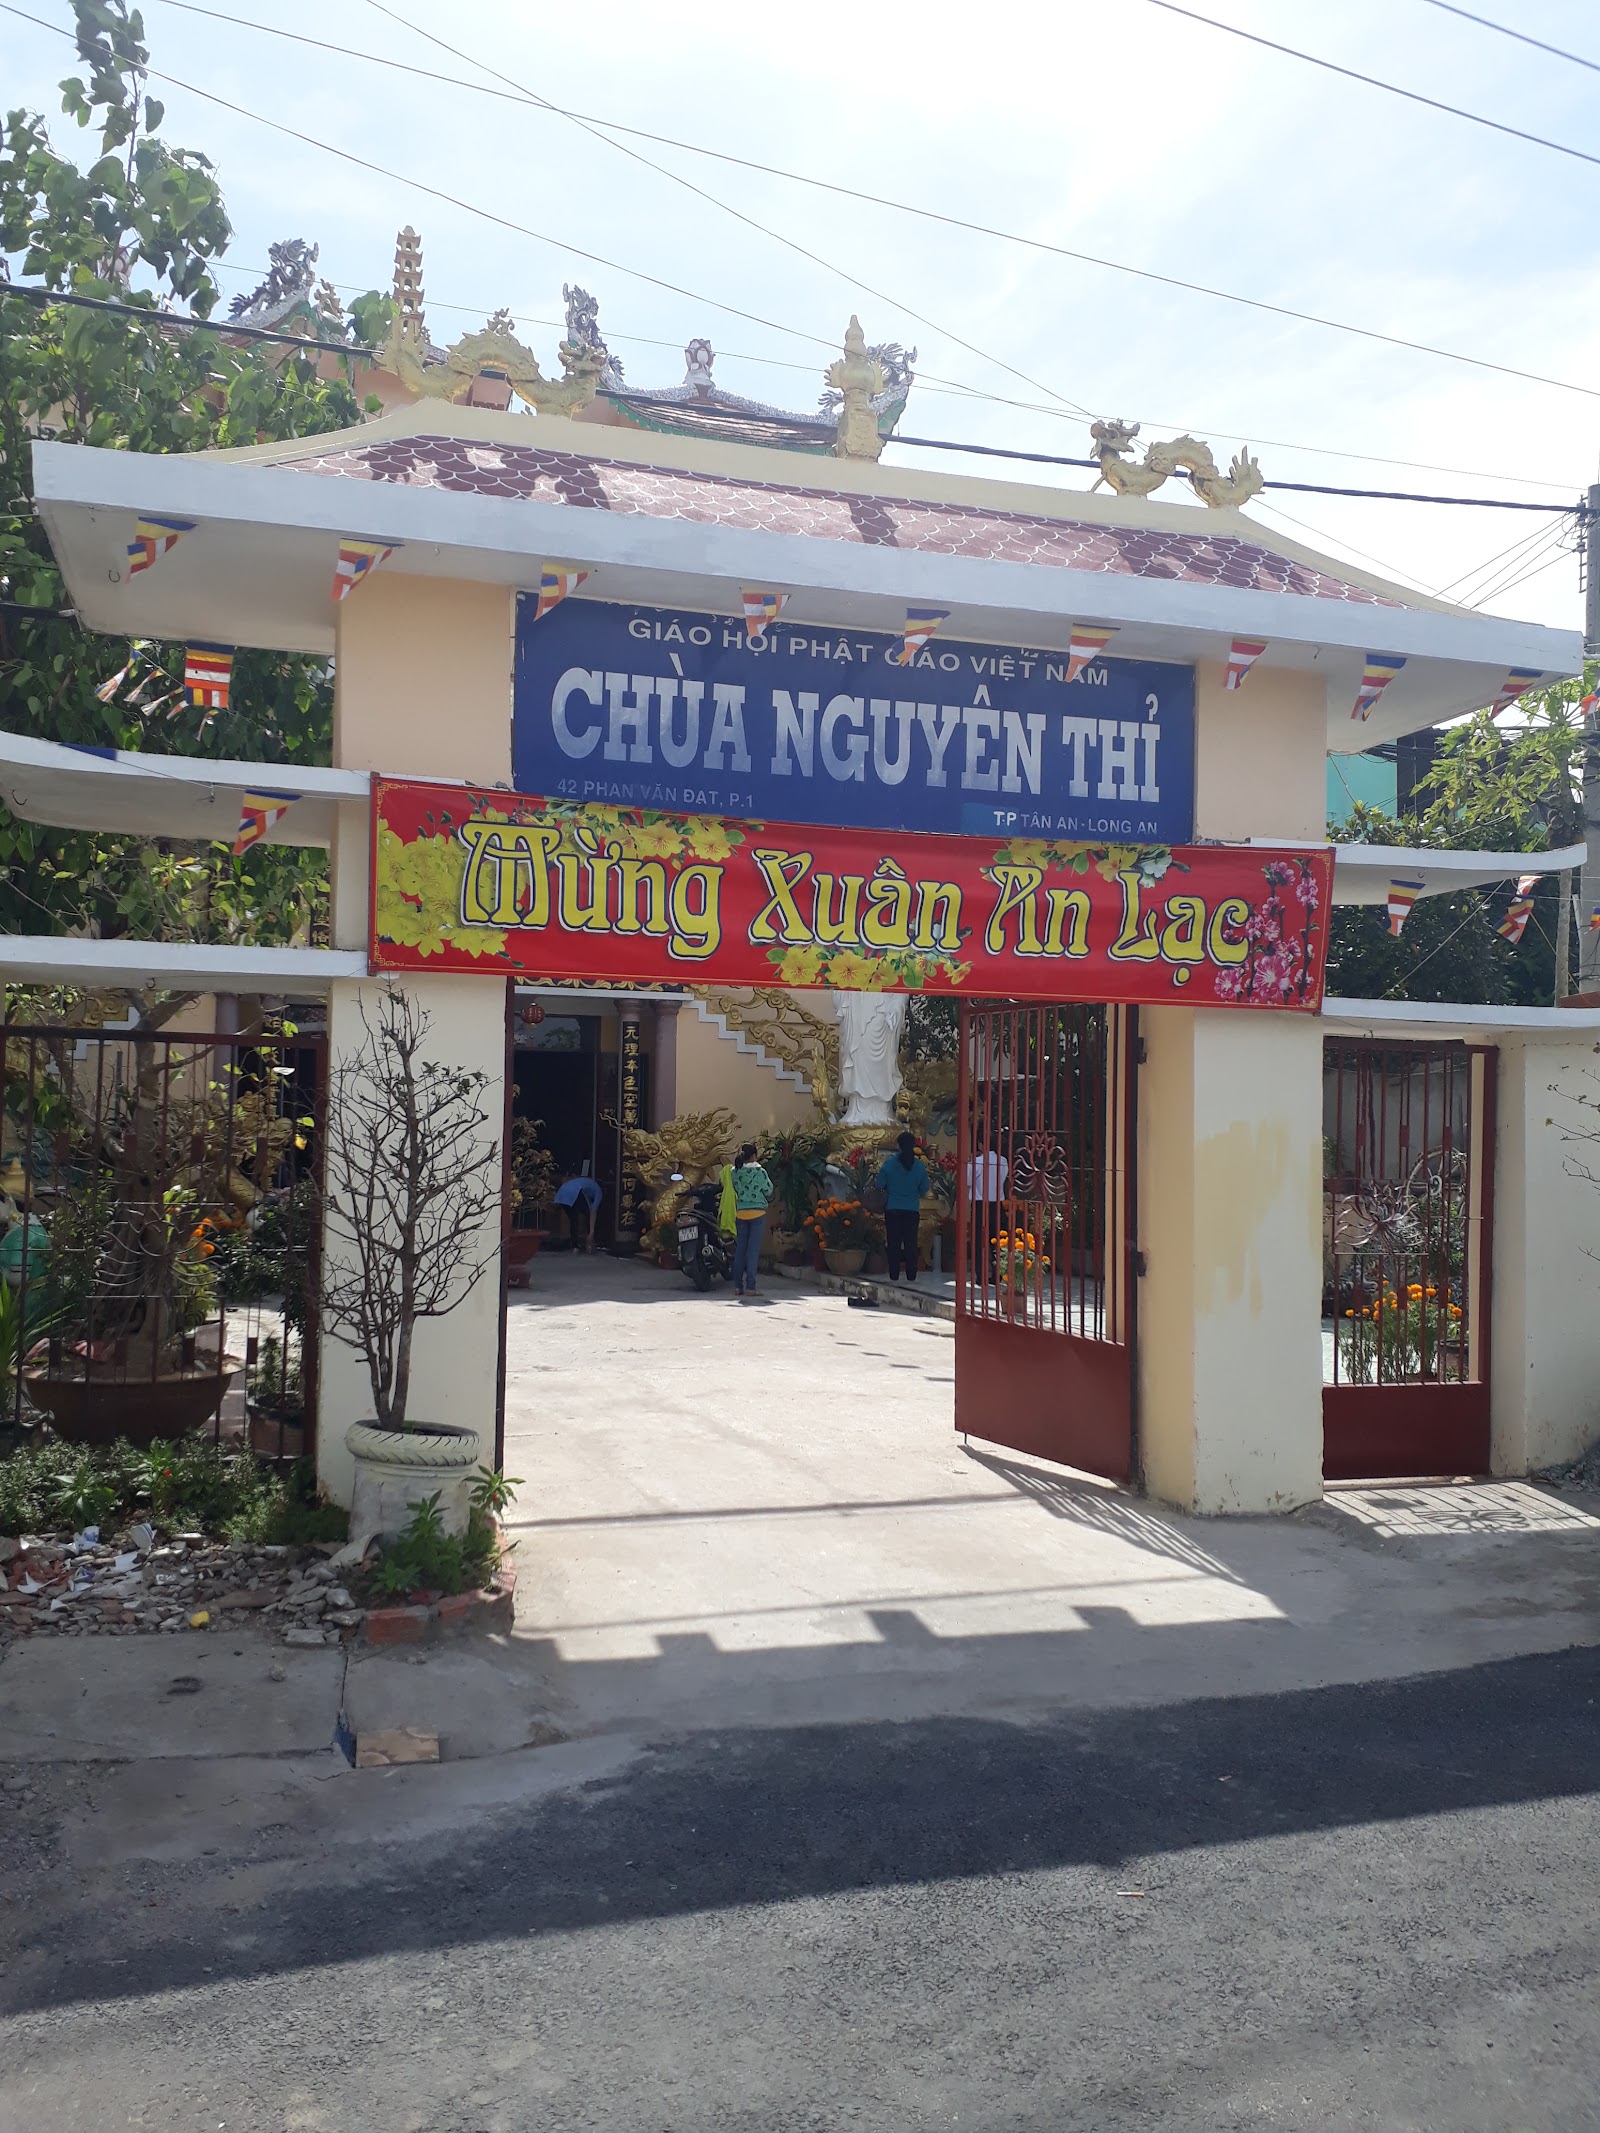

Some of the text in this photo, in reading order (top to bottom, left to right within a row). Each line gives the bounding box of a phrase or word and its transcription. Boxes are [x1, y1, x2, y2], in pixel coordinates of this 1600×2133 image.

[628, 618, 711, 646] GIÁO
[789, 637, 874, 665] PHẬT
[970, 654, 1036, 681] VIỆT
[551, 652, 1161, 803] CHÙA NGUYÊN THỈ
[558, 778, 577, 794] 42
[584, 780, 634, 799] PHAN
[640, 783, 677, 802] VĂN
[729, 792, 753, 808] P.1
[1021, 812, 1051, 829] TÂN
[1137, 822, 1157, 835] AN
[459, 820, 1250, 987] Mừng Xuân An Lạc
